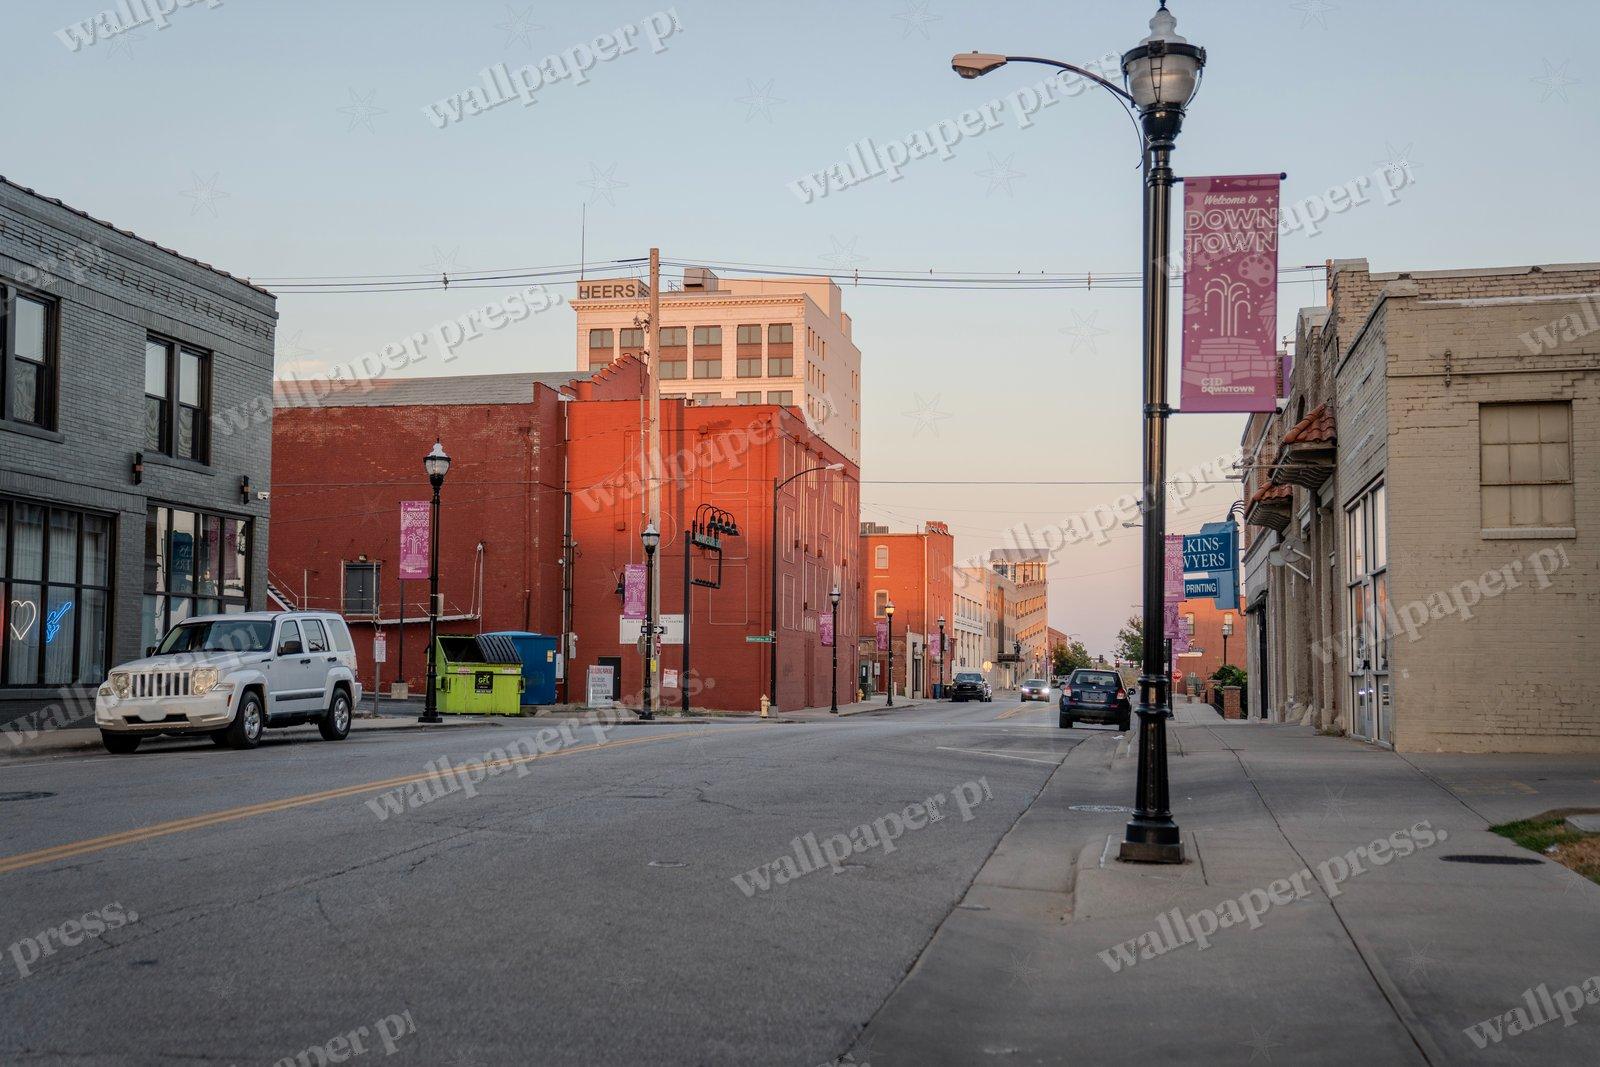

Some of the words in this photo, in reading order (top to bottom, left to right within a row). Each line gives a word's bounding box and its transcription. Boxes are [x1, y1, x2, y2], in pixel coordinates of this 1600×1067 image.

[1204, 195, 1246, 205] Welcome
[1248, 195, 1257, 203] to
[1185, 208, 1278, 231] DOWN
[1185, 232, 1277, 253] TOWN
[579, 284, 635, 299] HEERS
[1186, 583, 1217, 593] PRINTING
